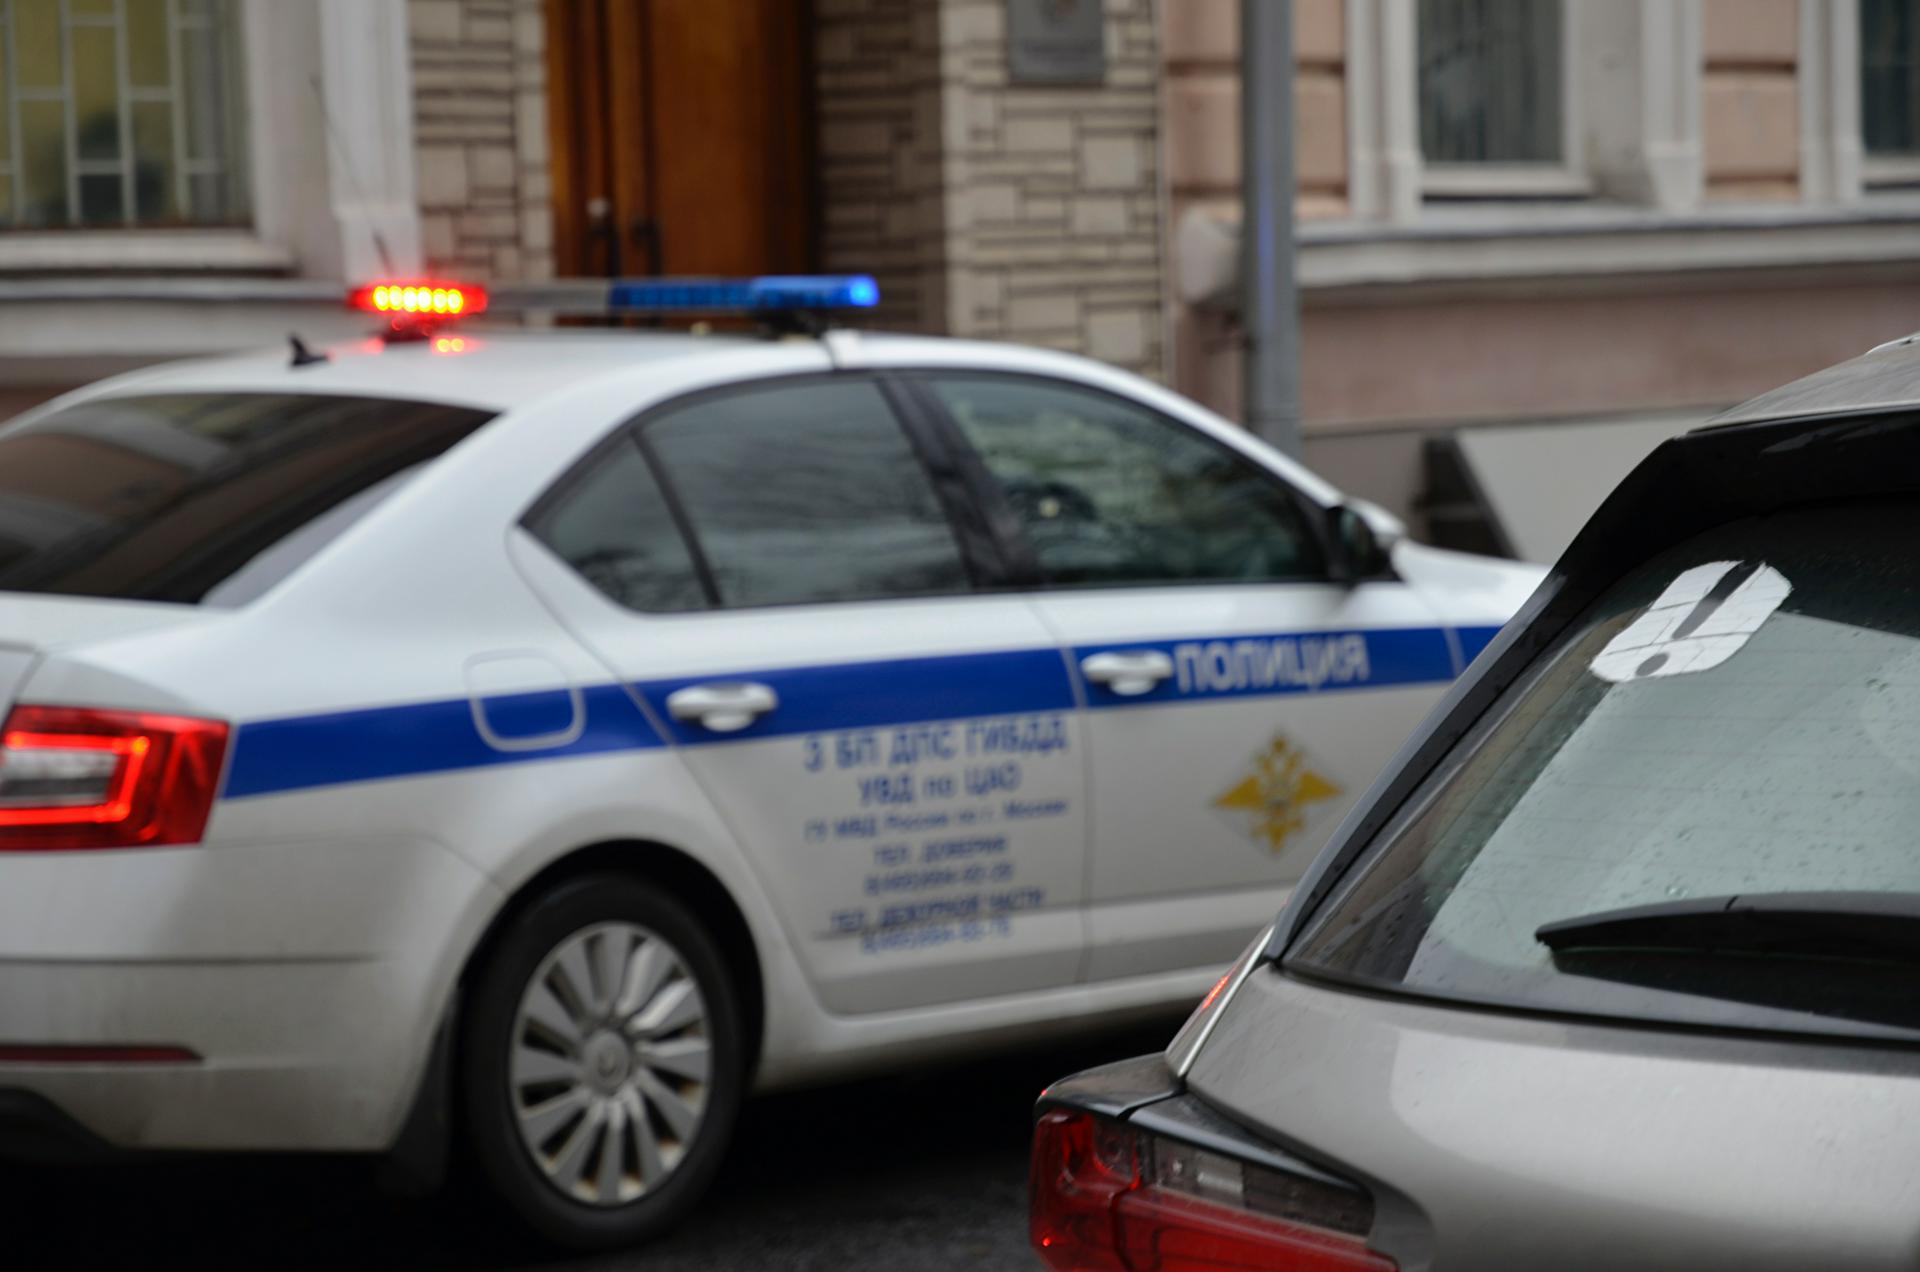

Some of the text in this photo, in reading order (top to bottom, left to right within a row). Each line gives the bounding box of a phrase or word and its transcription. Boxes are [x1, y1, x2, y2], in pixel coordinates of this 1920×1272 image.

[1173, 633, 1371, 693] ПОЛИЦИЯ
[804, 718, 1069, 772] 3 БП ДПС ГИБДД
[857, 763, 1022, 806] УВД по ЦАО
[834, 816, 876, 838] МВД
